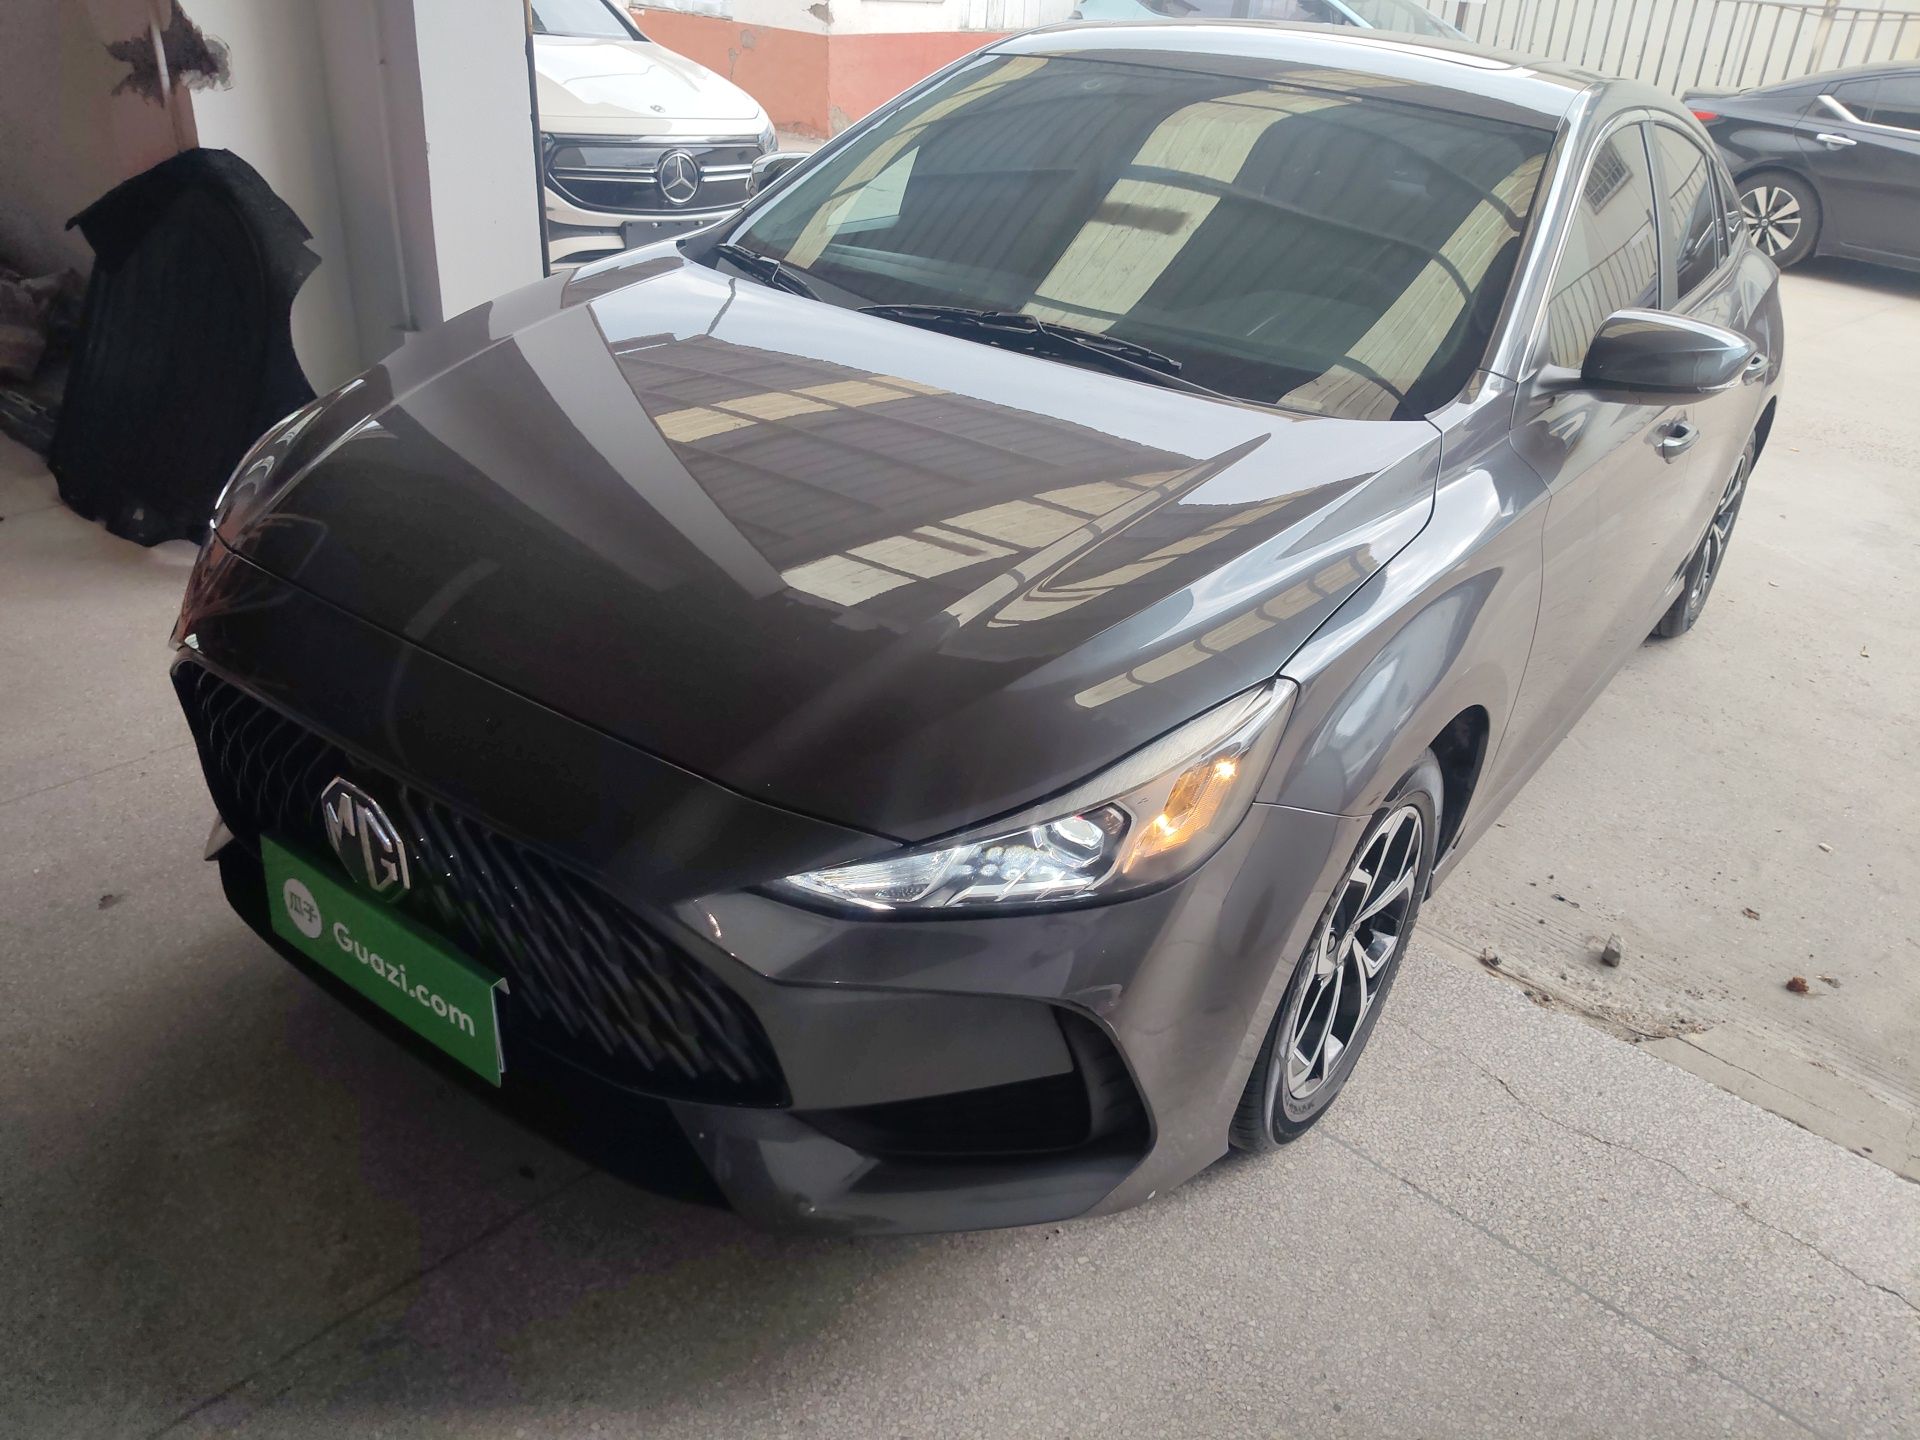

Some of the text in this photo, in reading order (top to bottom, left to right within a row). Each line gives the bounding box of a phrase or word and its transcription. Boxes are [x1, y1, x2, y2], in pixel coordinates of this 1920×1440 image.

[326, 792, 398, 892] MG
[288, 891, 318, 923] 瓜子
[333, 922, 475, 1037] Guazi.com
